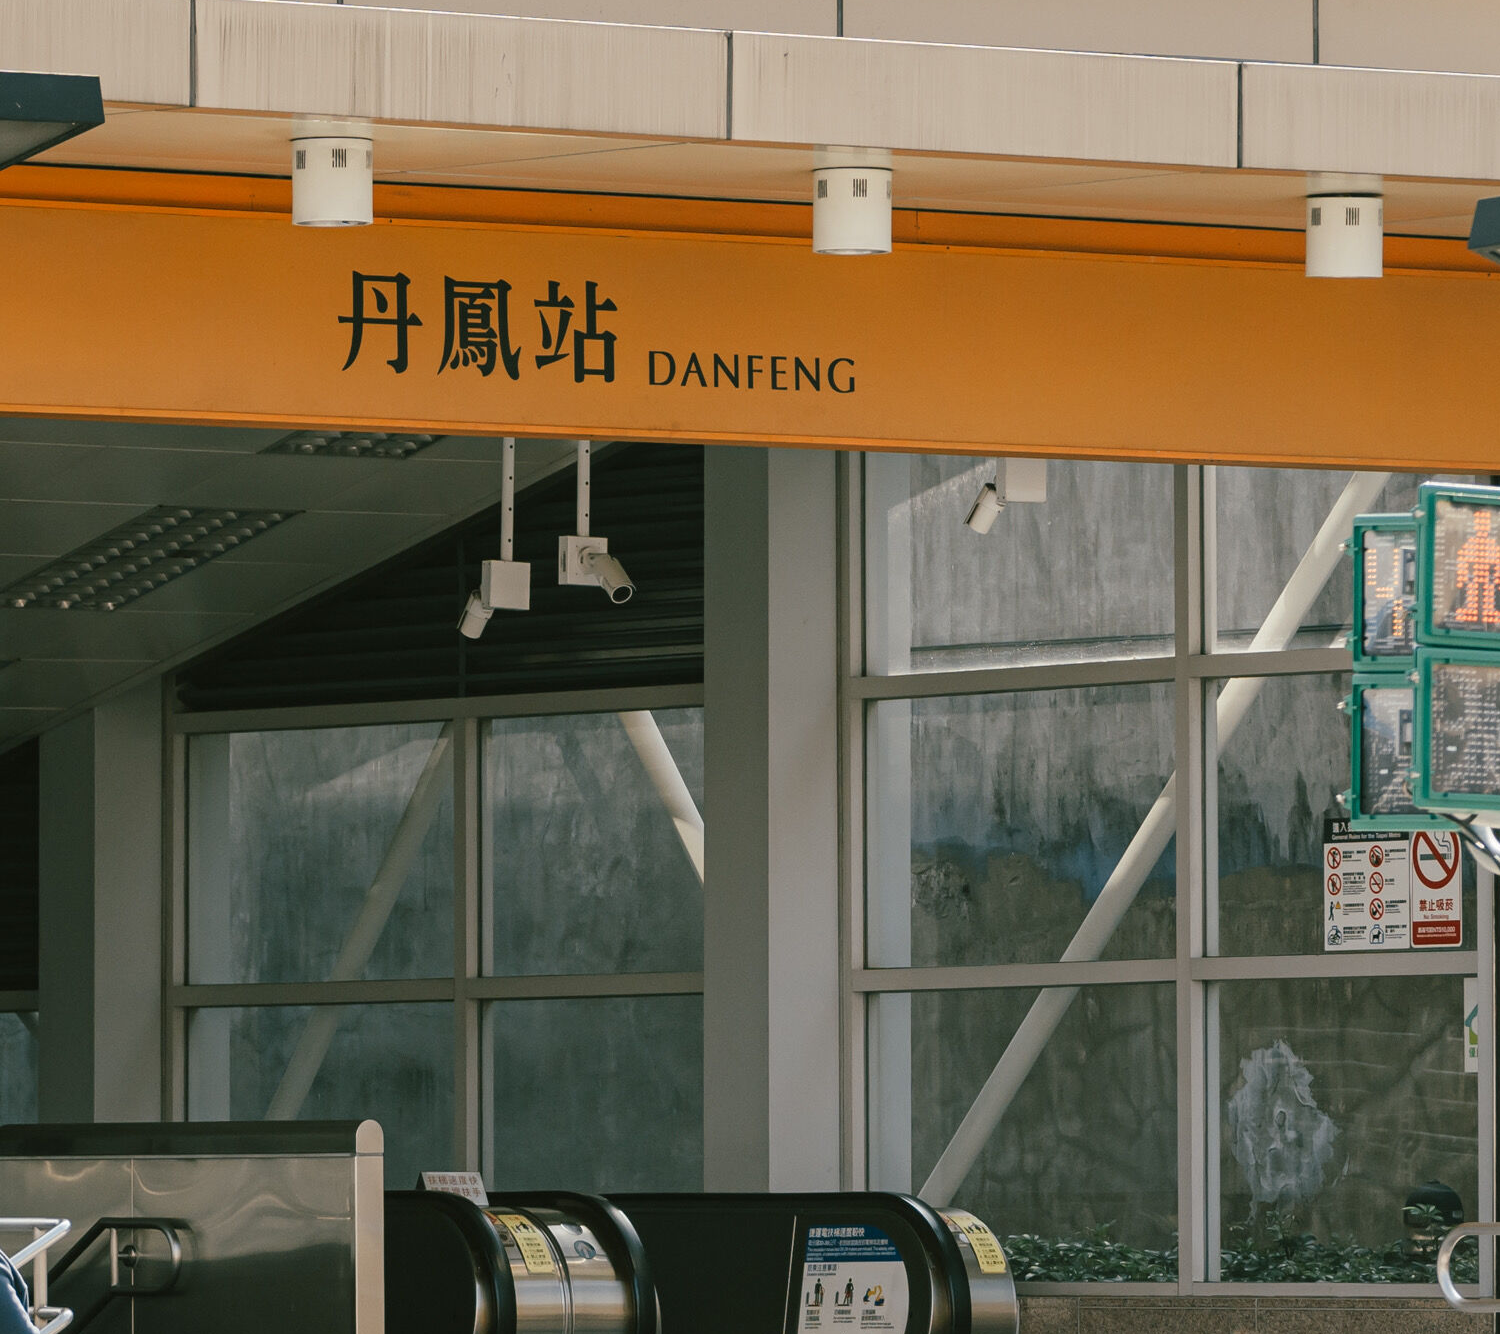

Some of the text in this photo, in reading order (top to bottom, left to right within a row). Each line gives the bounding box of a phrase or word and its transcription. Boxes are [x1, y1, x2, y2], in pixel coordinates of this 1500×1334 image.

[337, 270, 618, 384] 丹鳳站
[648, 350, 856, 393] DANFENG
[1419, 898, 1454, 911] 禁止吸菸
